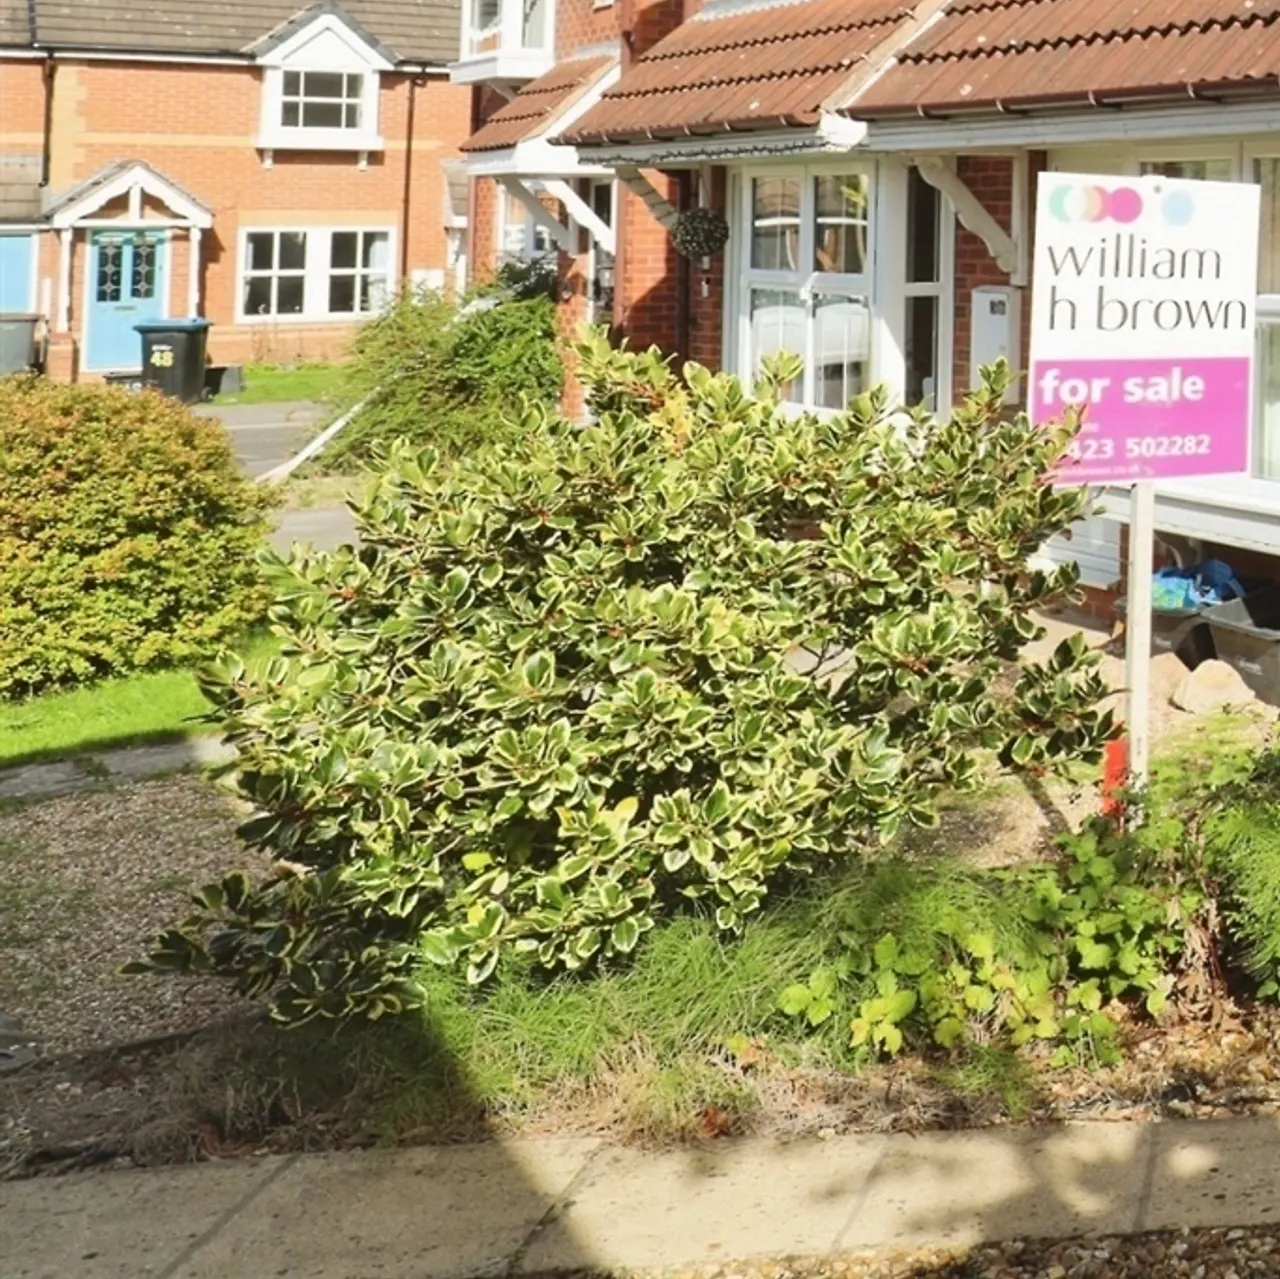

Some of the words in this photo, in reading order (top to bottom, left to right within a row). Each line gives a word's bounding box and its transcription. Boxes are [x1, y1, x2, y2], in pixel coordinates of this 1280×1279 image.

[1047, 233, 1221, 280] william
[1049, 285, 1077, 330] h
[1096, 285, 1248, 331] brown
[1039, 368, 1110, 404] for
[1123, 366, 1205, 403] sale
[1065, 438, 1115, 462] 423
[1125, 434, 1212, 460] 502282
